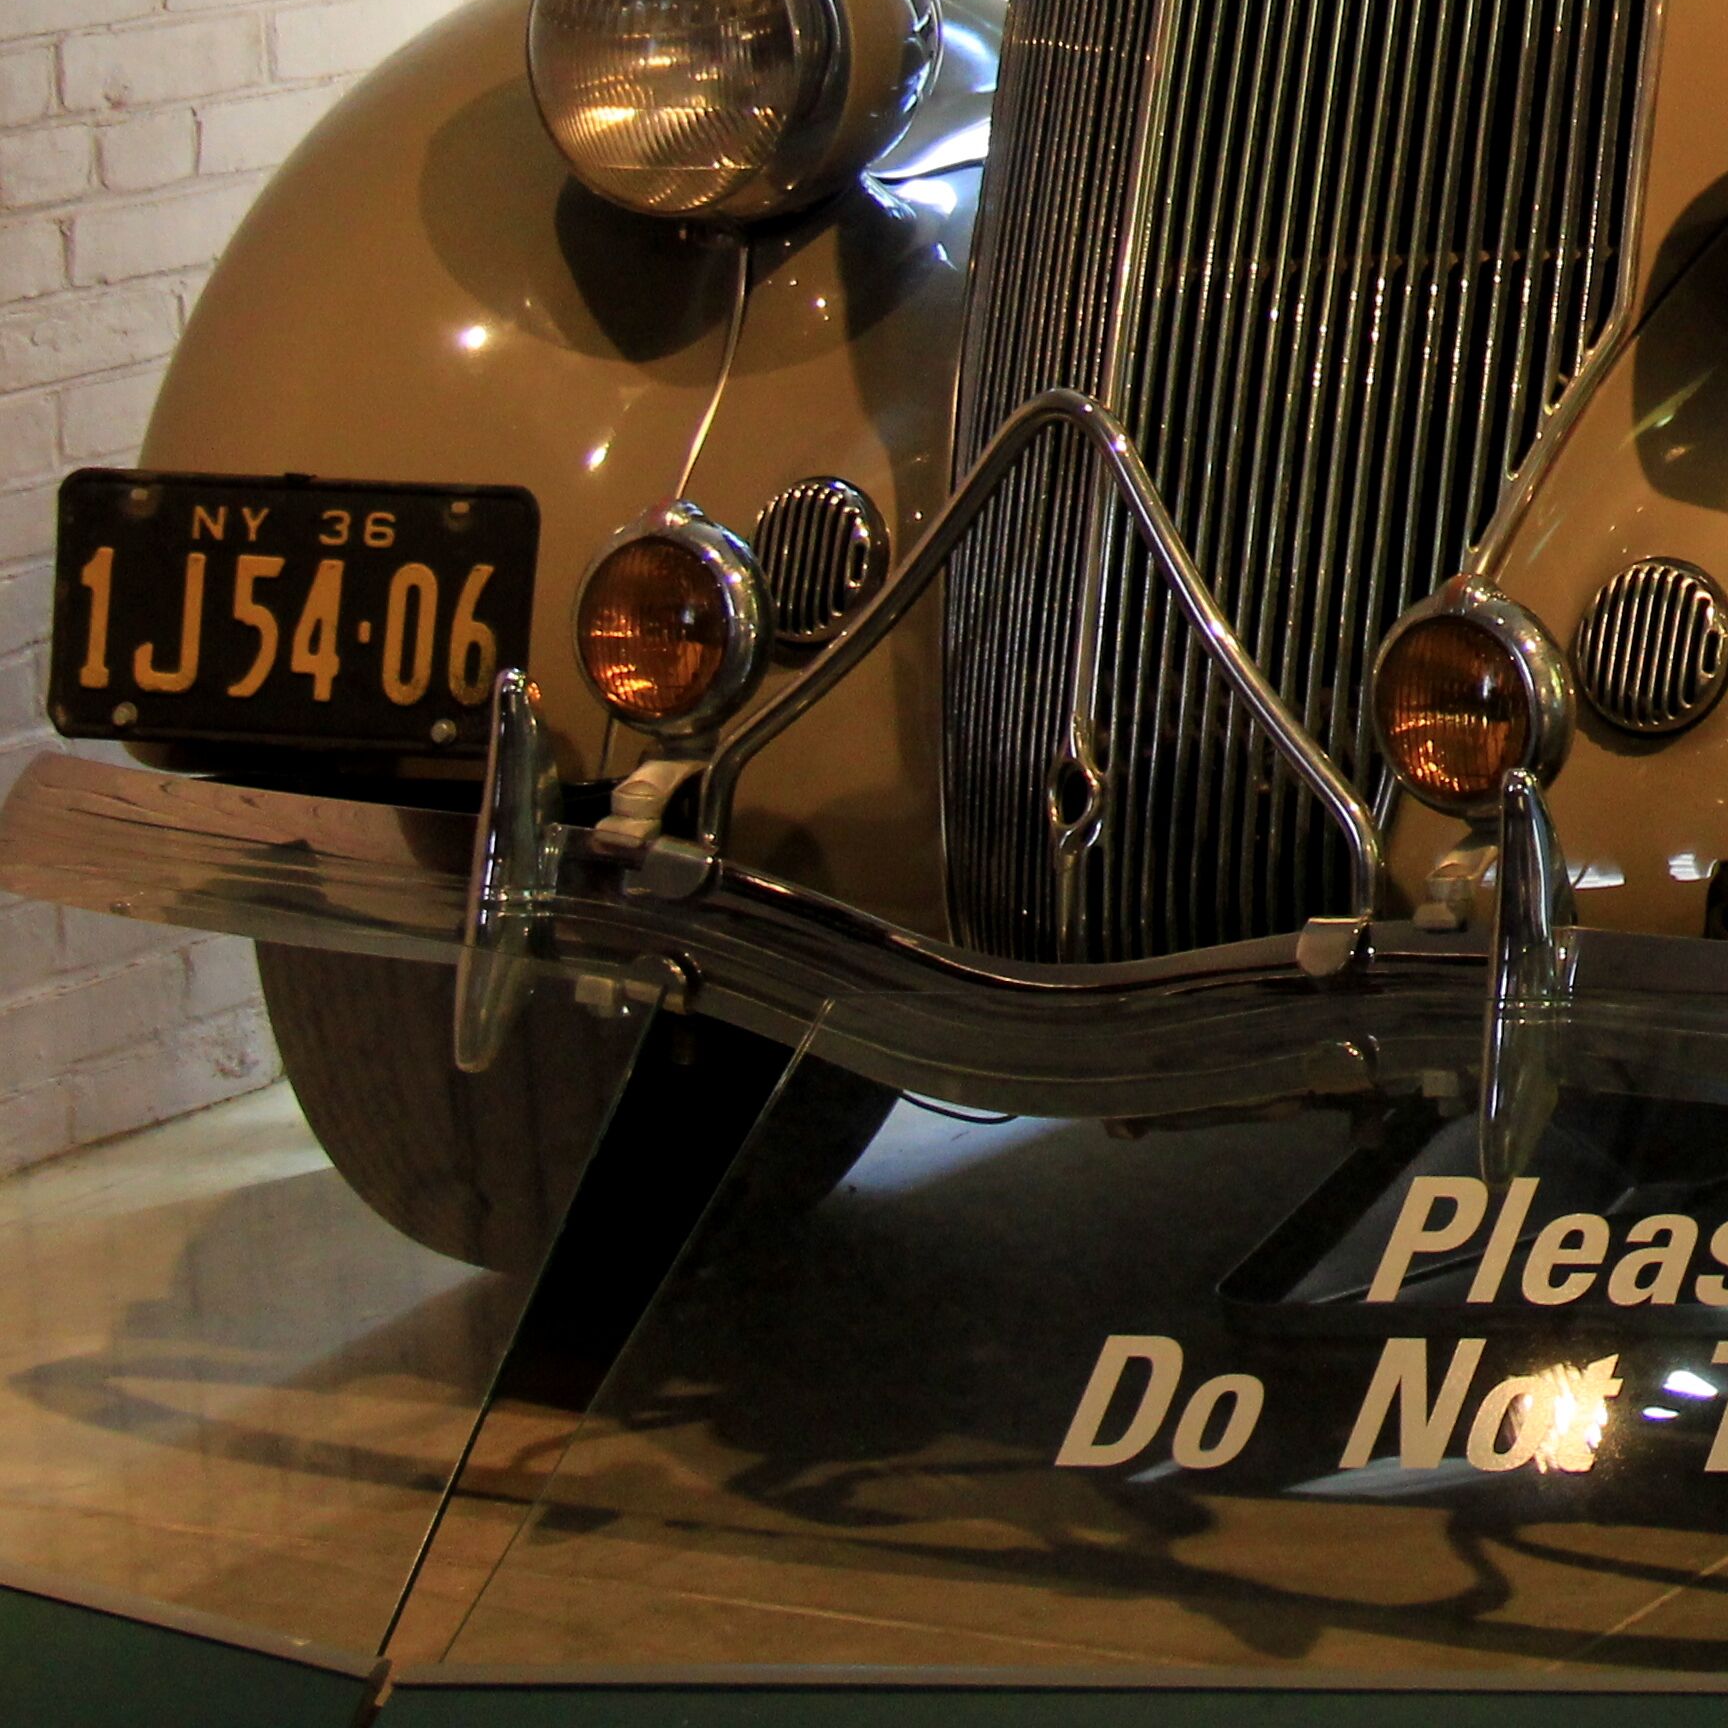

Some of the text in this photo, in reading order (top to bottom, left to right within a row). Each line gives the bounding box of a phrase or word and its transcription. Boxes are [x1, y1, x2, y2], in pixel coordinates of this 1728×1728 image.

[191, 504, 397, 549] NY 36
[1054, 1333, 1267, 1471] Do
[1338, 1336, 1624, 1475] Not
